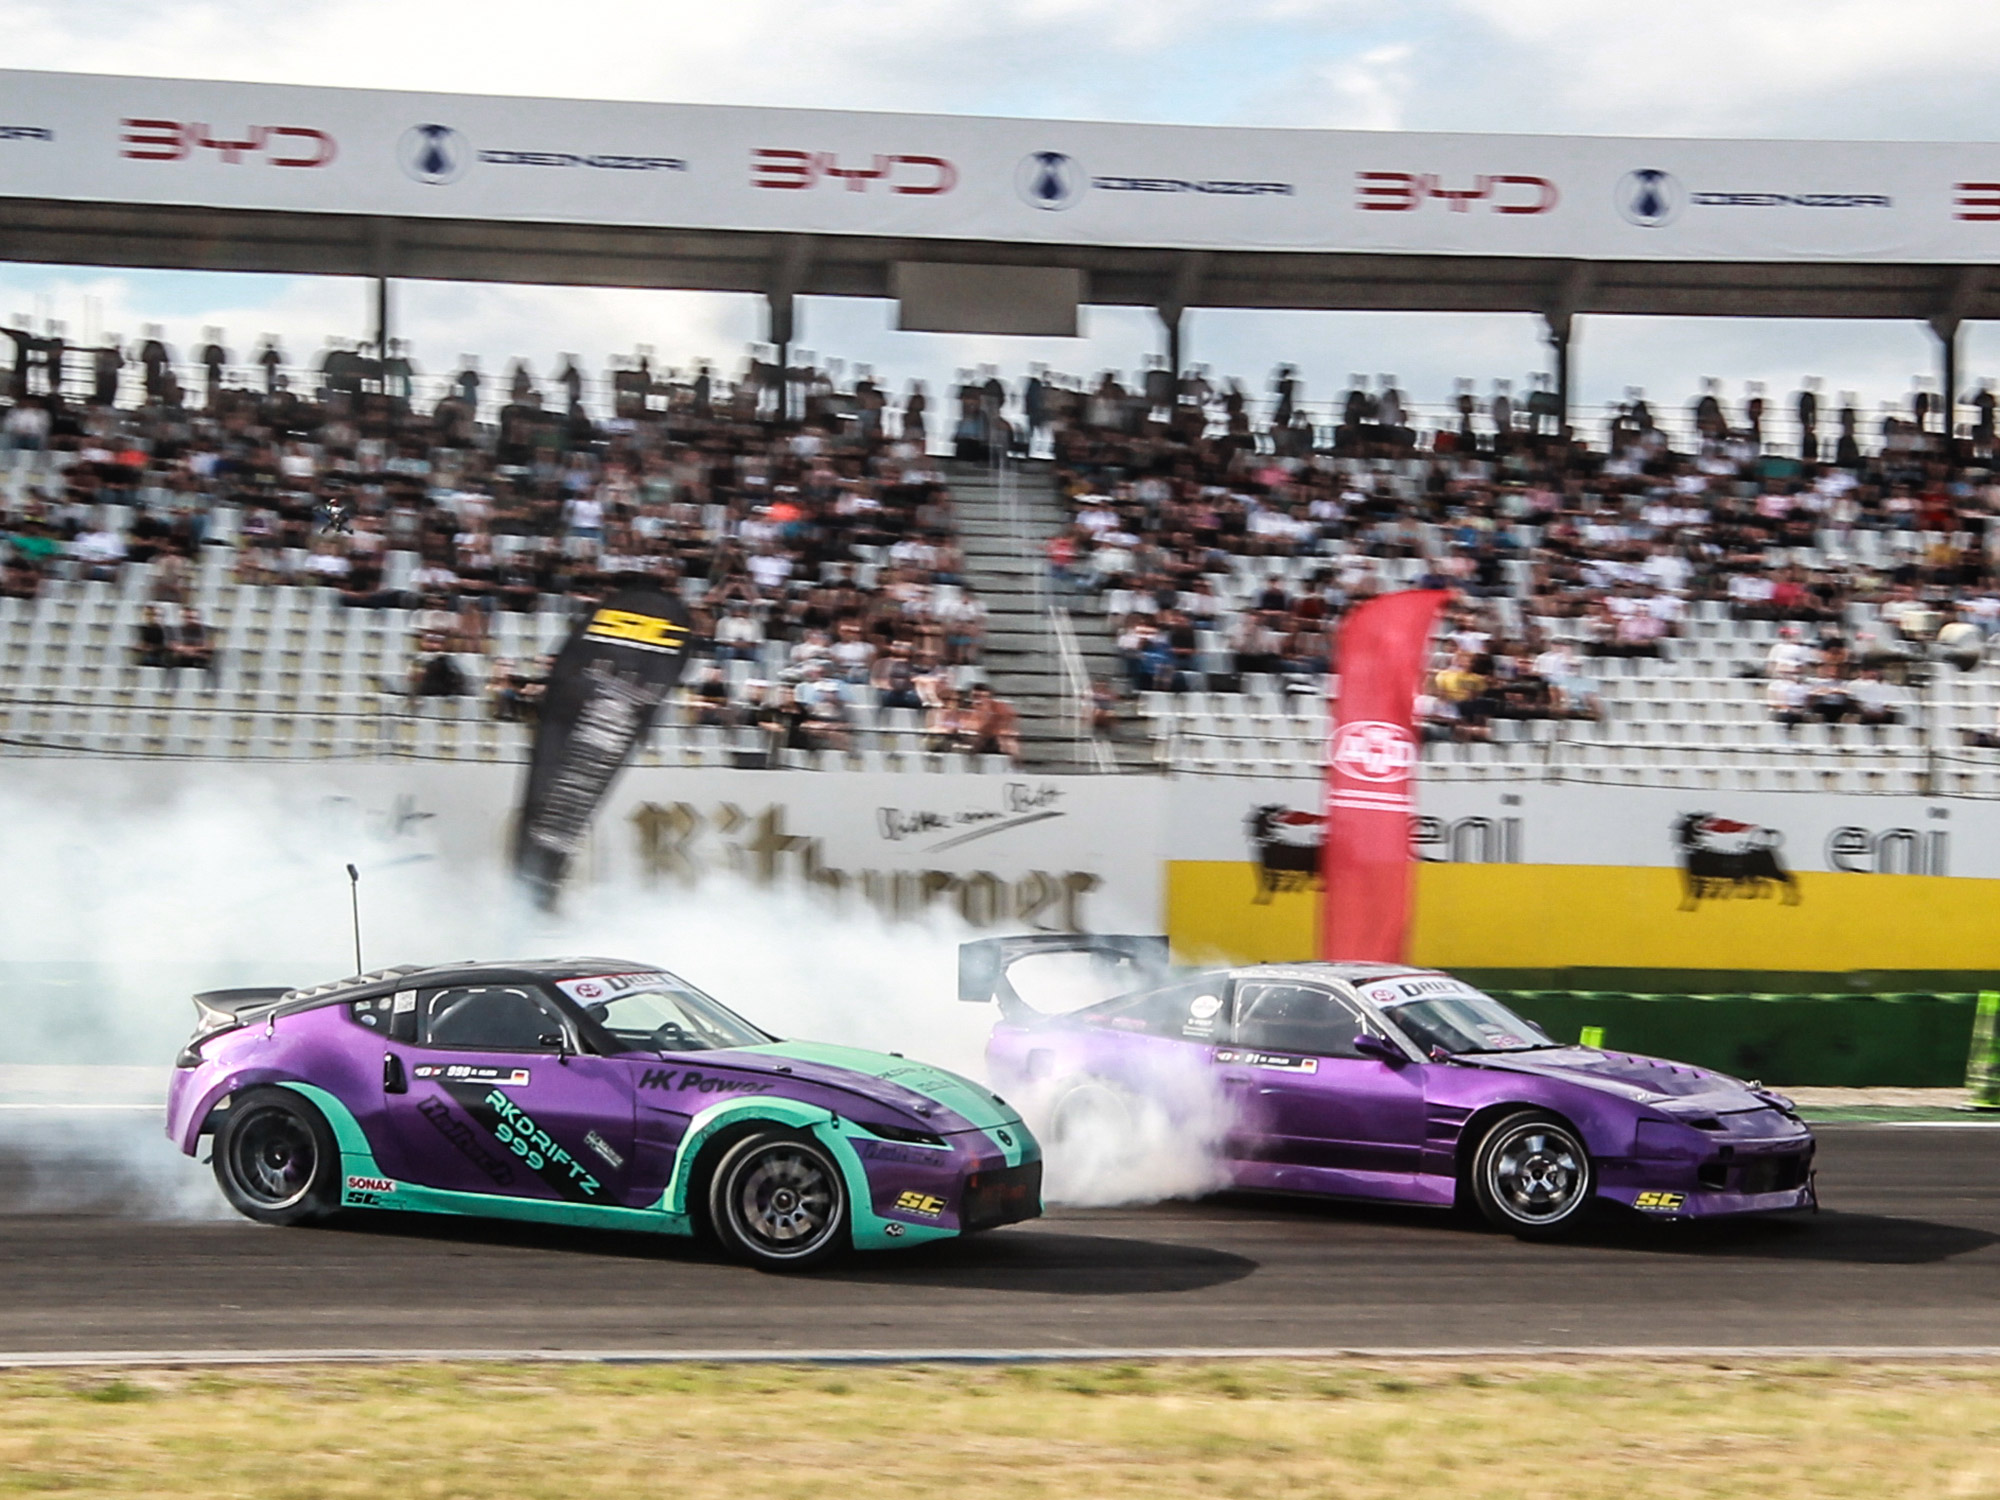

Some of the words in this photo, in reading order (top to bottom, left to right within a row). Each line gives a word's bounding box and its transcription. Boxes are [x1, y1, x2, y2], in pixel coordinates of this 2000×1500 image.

[119, 117, 338, 168] BYD
[750, 147, 959, 196] BYD
[1355, 170, 1559, 215] BYD
[638, 1068, 676, 1091] HK
[678, 1072, 775, 1093] Power
[485, 1089, 601, 1196] RKDRIFTZ
[494, 1123, 544, 1171] 999
[348, 1177, 393, 1191] SONAX
